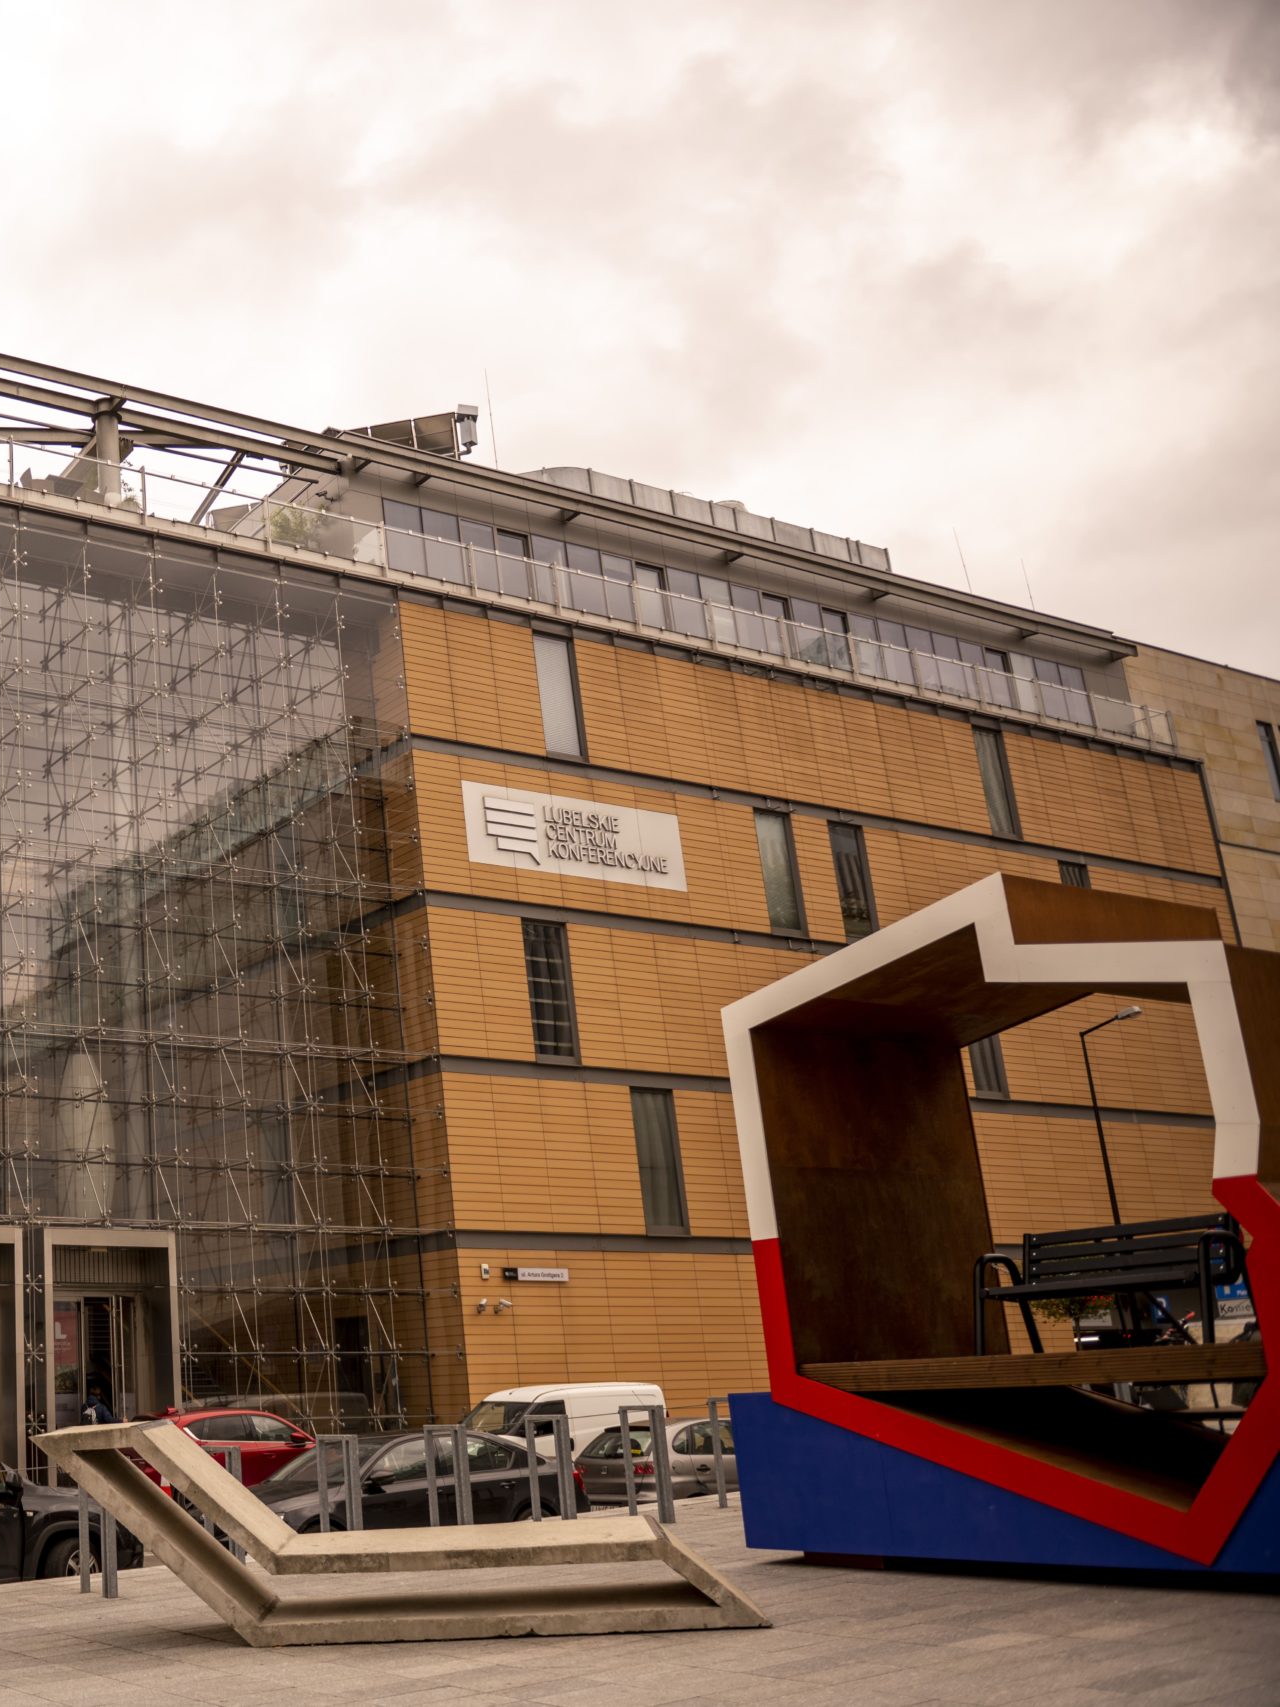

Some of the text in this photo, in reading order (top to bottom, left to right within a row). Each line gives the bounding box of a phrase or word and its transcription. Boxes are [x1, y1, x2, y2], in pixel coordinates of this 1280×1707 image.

[542, 805, 620, 834] LUBELSKIE
[545, 824, 618, 850] CENTRUM
[547, 842, 669, 875] KONFERENCYJNE
